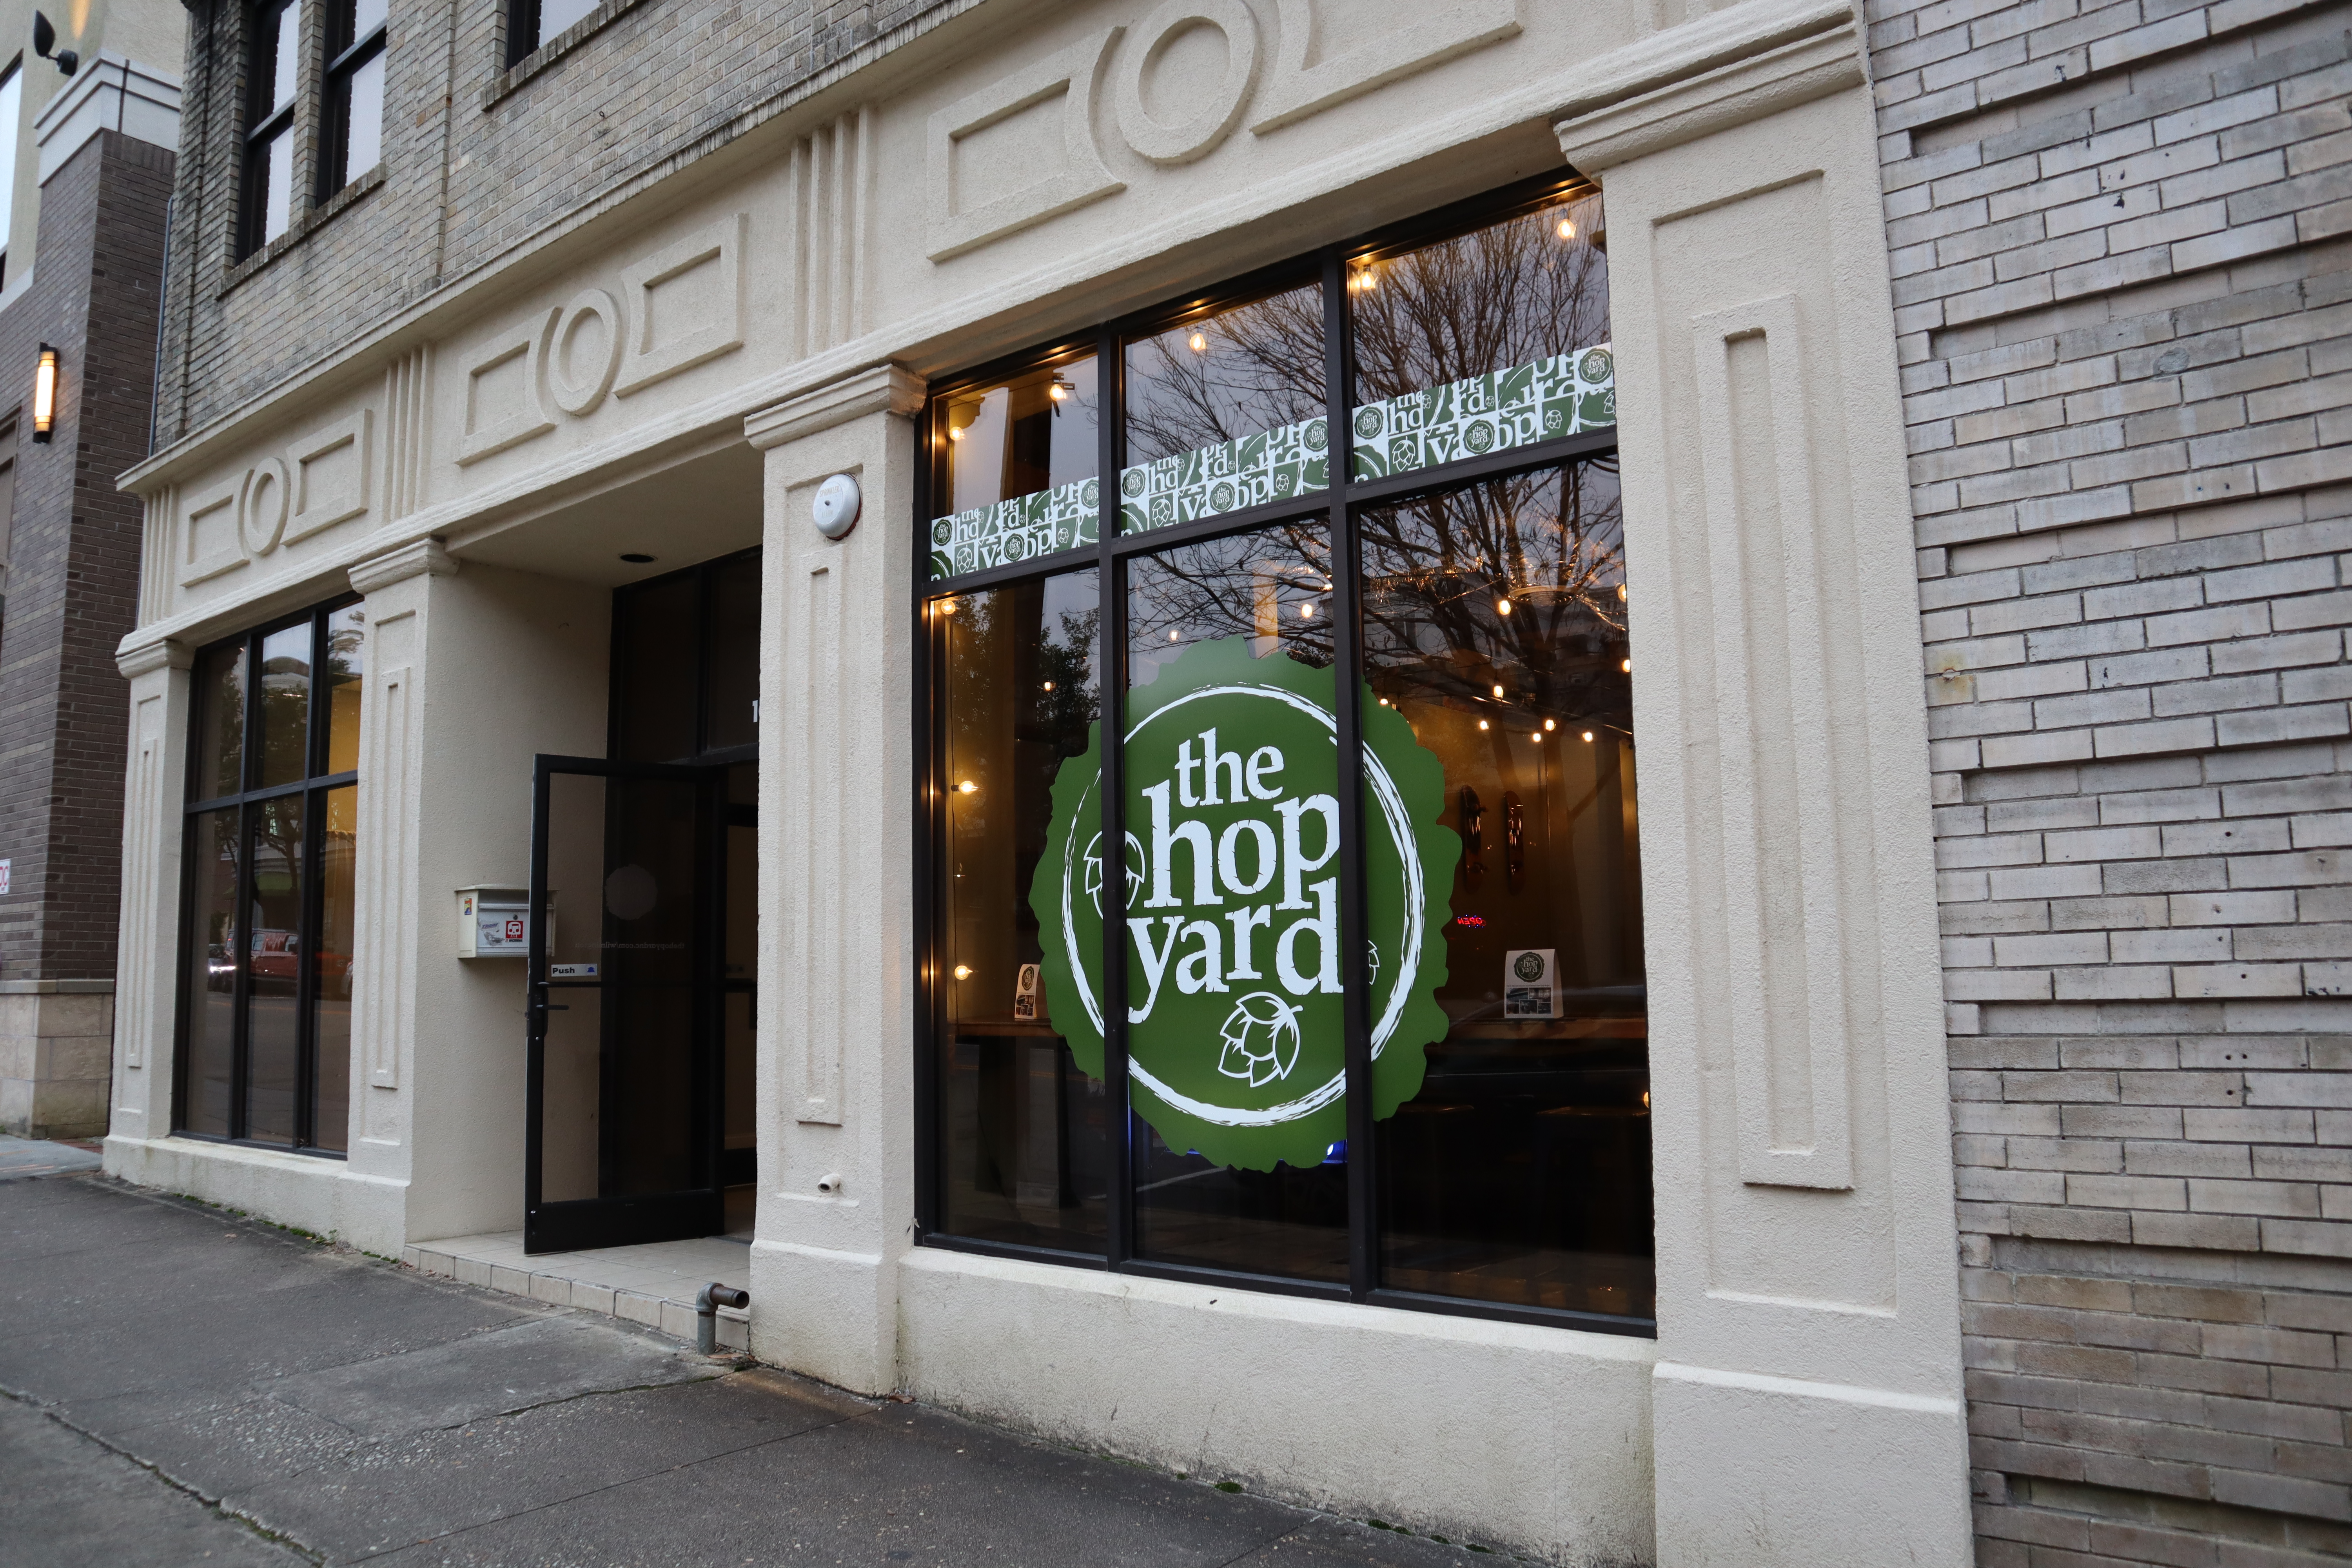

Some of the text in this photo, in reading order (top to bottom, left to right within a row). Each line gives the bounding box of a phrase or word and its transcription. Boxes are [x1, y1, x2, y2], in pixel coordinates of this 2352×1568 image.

[1588, 358, 1605, 366] hop
[1587, 363, 1605, 377] yard
[1363, 415, 1377, 423] hop
[1362, 420, 1377, 433] yard
[1312, 428, 1325, 436] hop
[1472, 428, 1488, 437] hop
[1310, 434, 1325, 445] yard
[1471, 435, 1488, 447] yard
[820, 486, 839, 497] SPRINKLER
[1128, 481, 1140, 492] yard
[1086, 492, 1098, 502] yard
[1217, 490, 1229, 498] hop
[1216, 496, 1229, 506] yard
[1009, 546, 1020, 555] yard
[1174, 727, 1284, 808] the
[1142, 779, 1340, 911] hop
[1127, 877, 1343, 1024] yard
[1524, 959, 1538, 967] hop
[1521, 965, 1537, 975] yard
